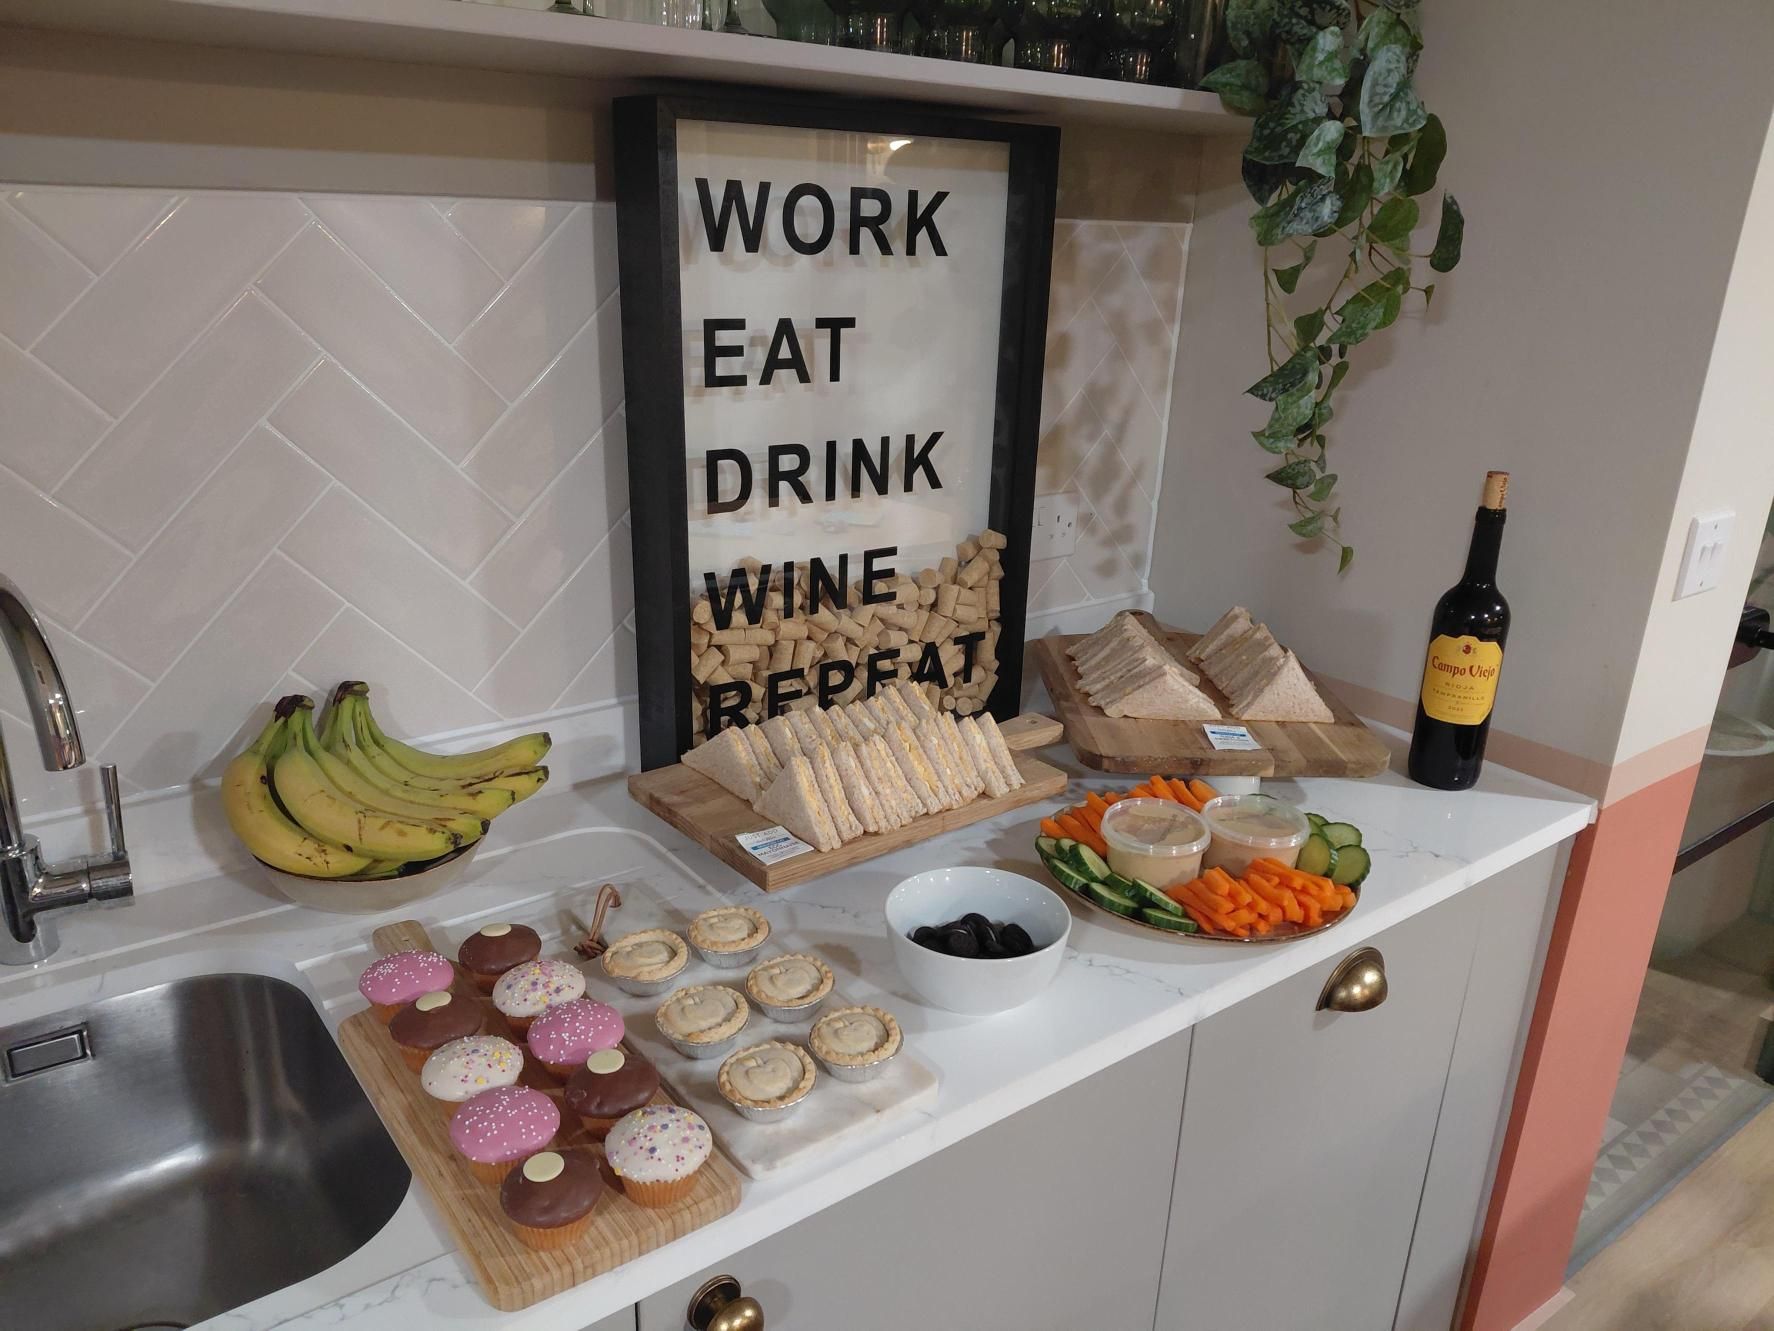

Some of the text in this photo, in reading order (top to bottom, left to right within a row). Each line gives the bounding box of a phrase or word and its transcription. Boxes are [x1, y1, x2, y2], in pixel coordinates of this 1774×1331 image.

[695, 178, 951, 257] WORK
[703, 317, 856, 388] EAT
[706, 431, 944, 515] DRINK
[703, 546, 898, 631] WINE
[707, 632, 986, 740] REPEAT
[1432, 655, 1495, 680] Campo Viejo
[1444, 682, 1475, 690] RIOJA
